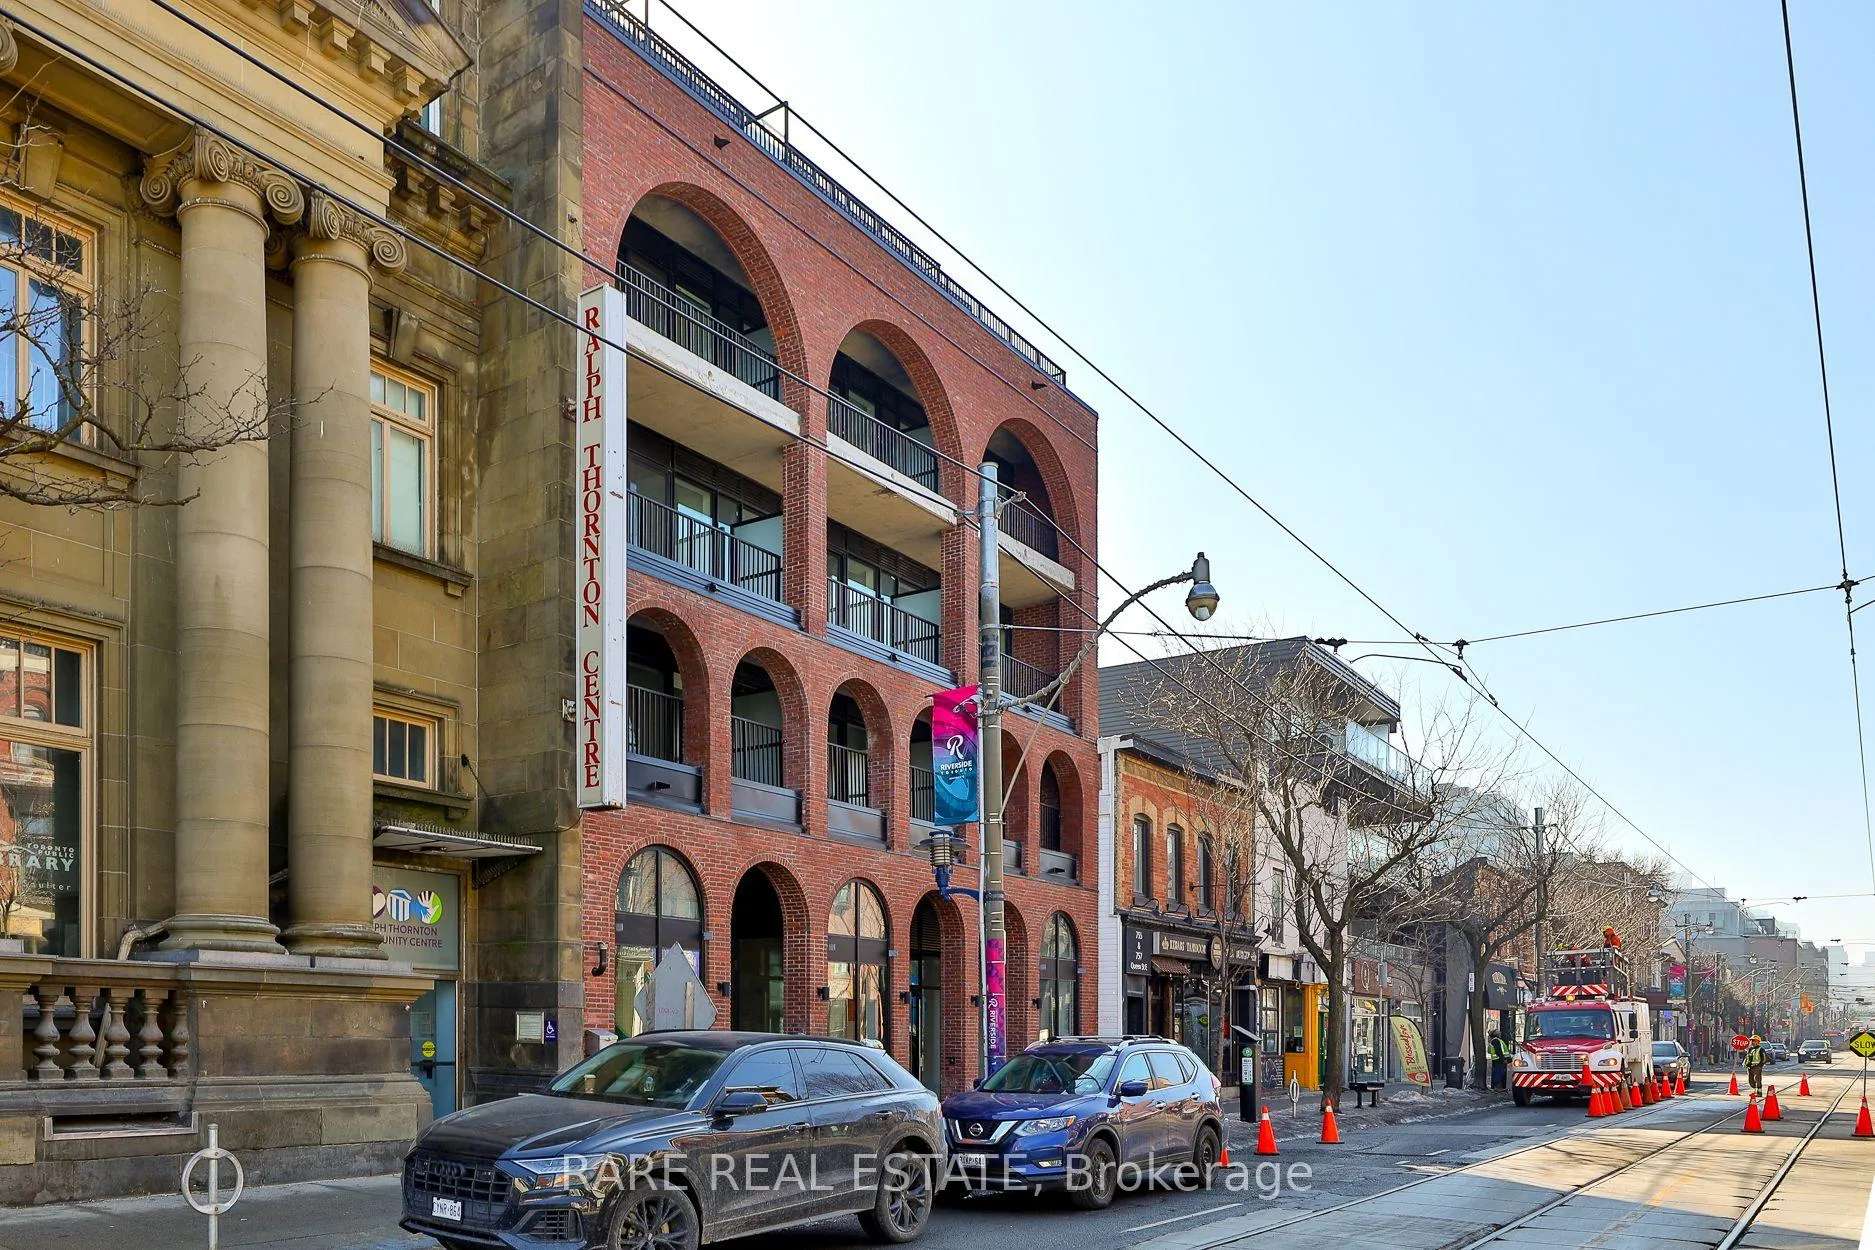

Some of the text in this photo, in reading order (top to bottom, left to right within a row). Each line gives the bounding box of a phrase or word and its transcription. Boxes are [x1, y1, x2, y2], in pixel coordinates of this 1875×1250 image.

[583, 306, 602, 788] RALPH THORNTON CENTRE
[940, 760, 973, 772] RIVERSIDE
[26, 842, 75, 853] TORONTO
[38, 850, 74, 859] PUBLIC
[388, 924, 438, 936] THORNTON
[383, 936, 443, 948] UNITY CENTRE
[1732, 1039, 1749, 1047] STOP
